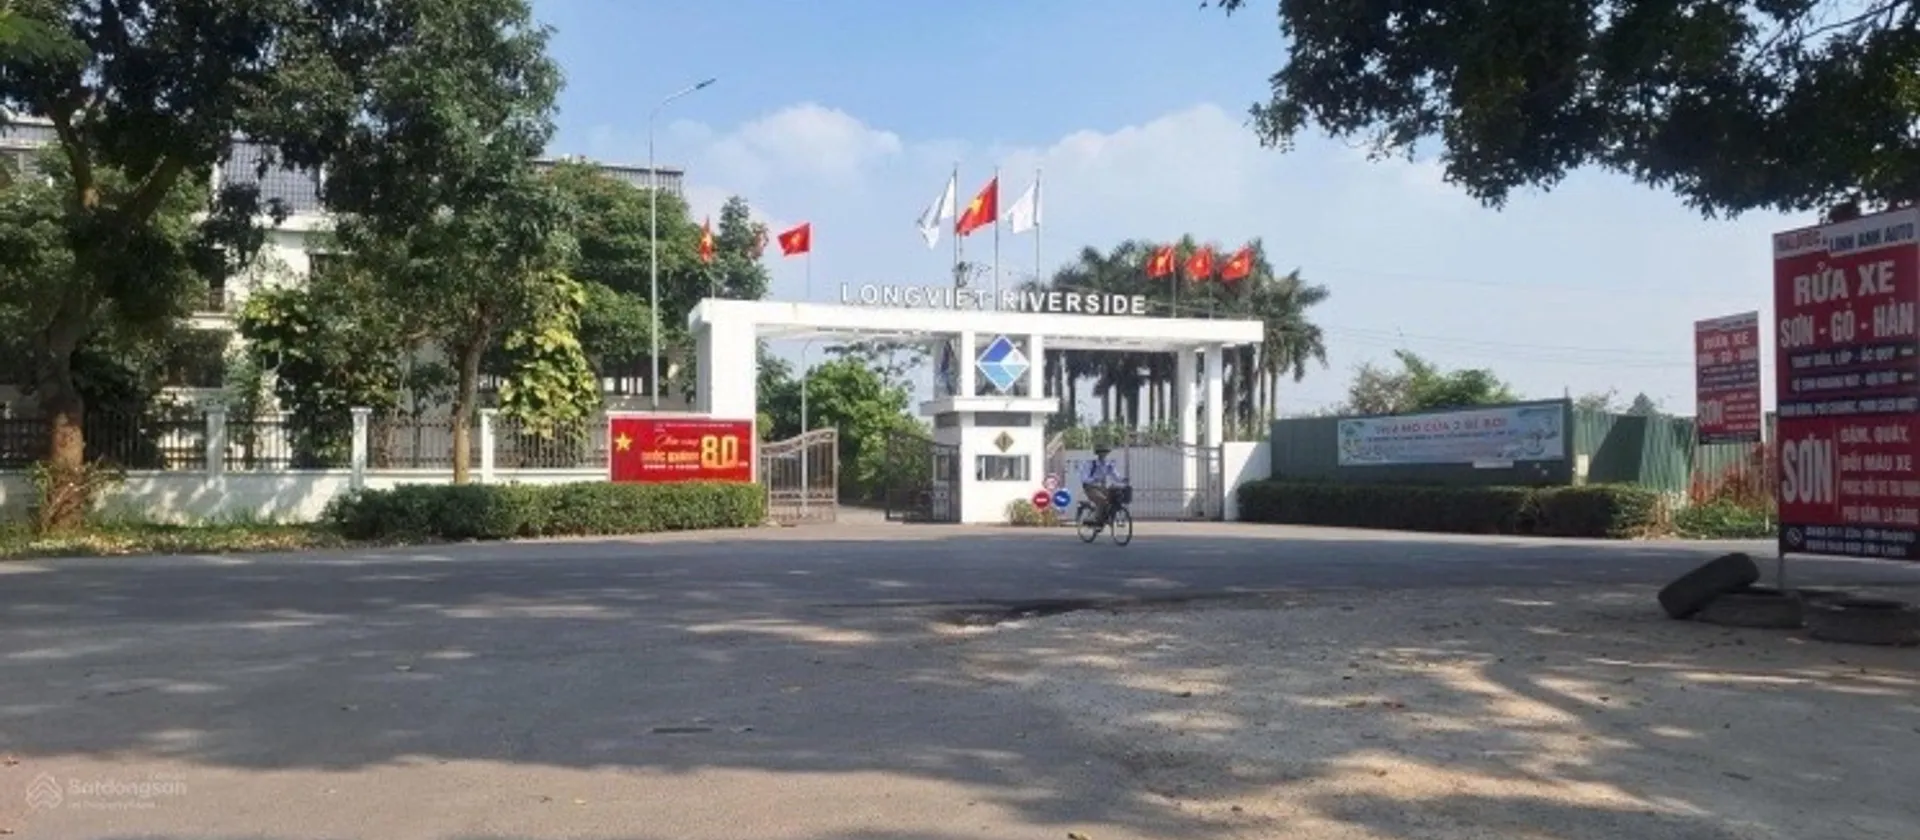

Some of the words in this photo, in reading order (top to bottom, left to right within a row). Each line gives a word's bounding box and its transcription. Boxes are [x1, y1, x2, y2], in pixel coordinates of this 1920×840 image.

[1883, 222, 1915, 243] AUTO
[841, 283, 988, 310] LONGVIET
[1001, 291, 1147, 314] RIVERSIDE
[1794, 261, 1849, 306] RỬA
[1858, 260, 1896, 296] XE
[1732, 330, 1750, 347] XE
[1780, 313, 1815, 348] SƠN
[1831, 302, 1855, 342] GÒ
[1873, 297, 1914, 337] HÀN
[701, 434, 739, 469] 80
[1782, 432, 1833, 504] SƠN
[1895, 454, 1913, 471] XE
